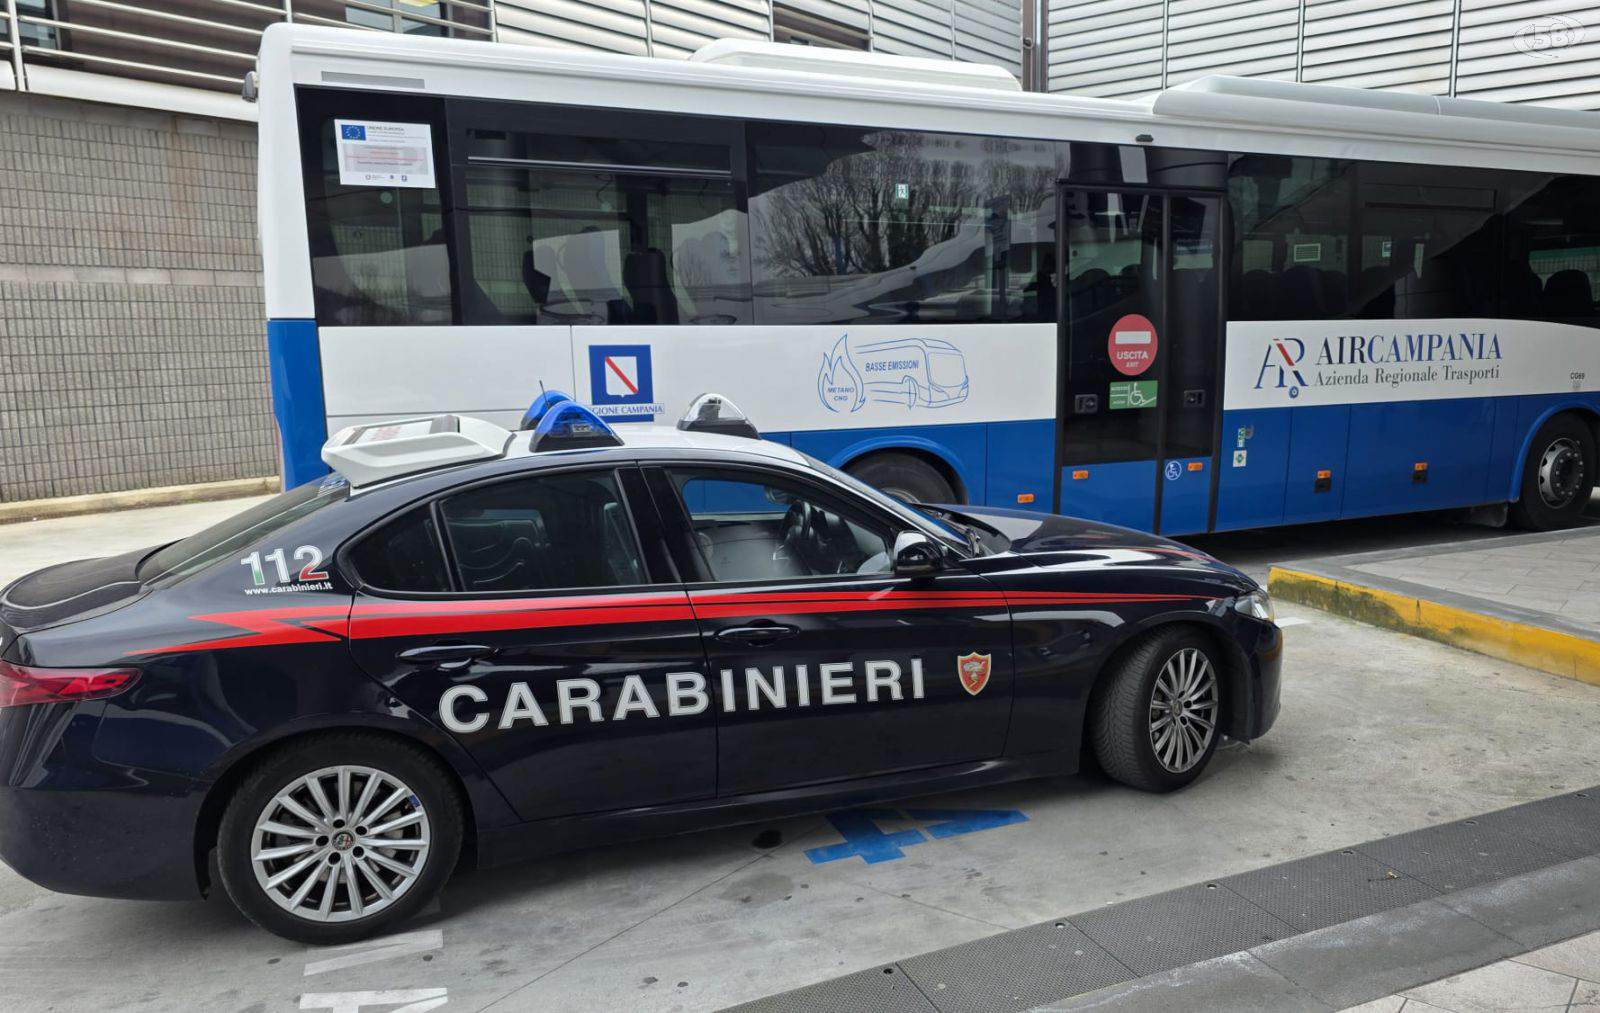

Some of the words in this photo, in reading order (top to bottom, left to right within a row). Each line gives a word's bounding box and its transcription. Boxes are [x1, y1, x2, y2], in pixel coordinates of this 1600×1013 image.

[1116, 351, 1149, 360] USCITA
[1316, 334, 1502, 365] AIRCAMPANIA
[865, 361, 886, 372] BASSE
[888, 360, 919, 371] EMISSIONI
[1314, 369, 1368, 386] Azienda
[1376, 366, 1438, 388] Regionale
[1443, 365, 1500, 385] Trasporti
[621, 403, 664, 414] CAMPANIA
[240, 544, 330, 586] 112
[244, 581, 334, 596] www.carabinieri.it
[438, 657, 926, 734] CARABINIERI
